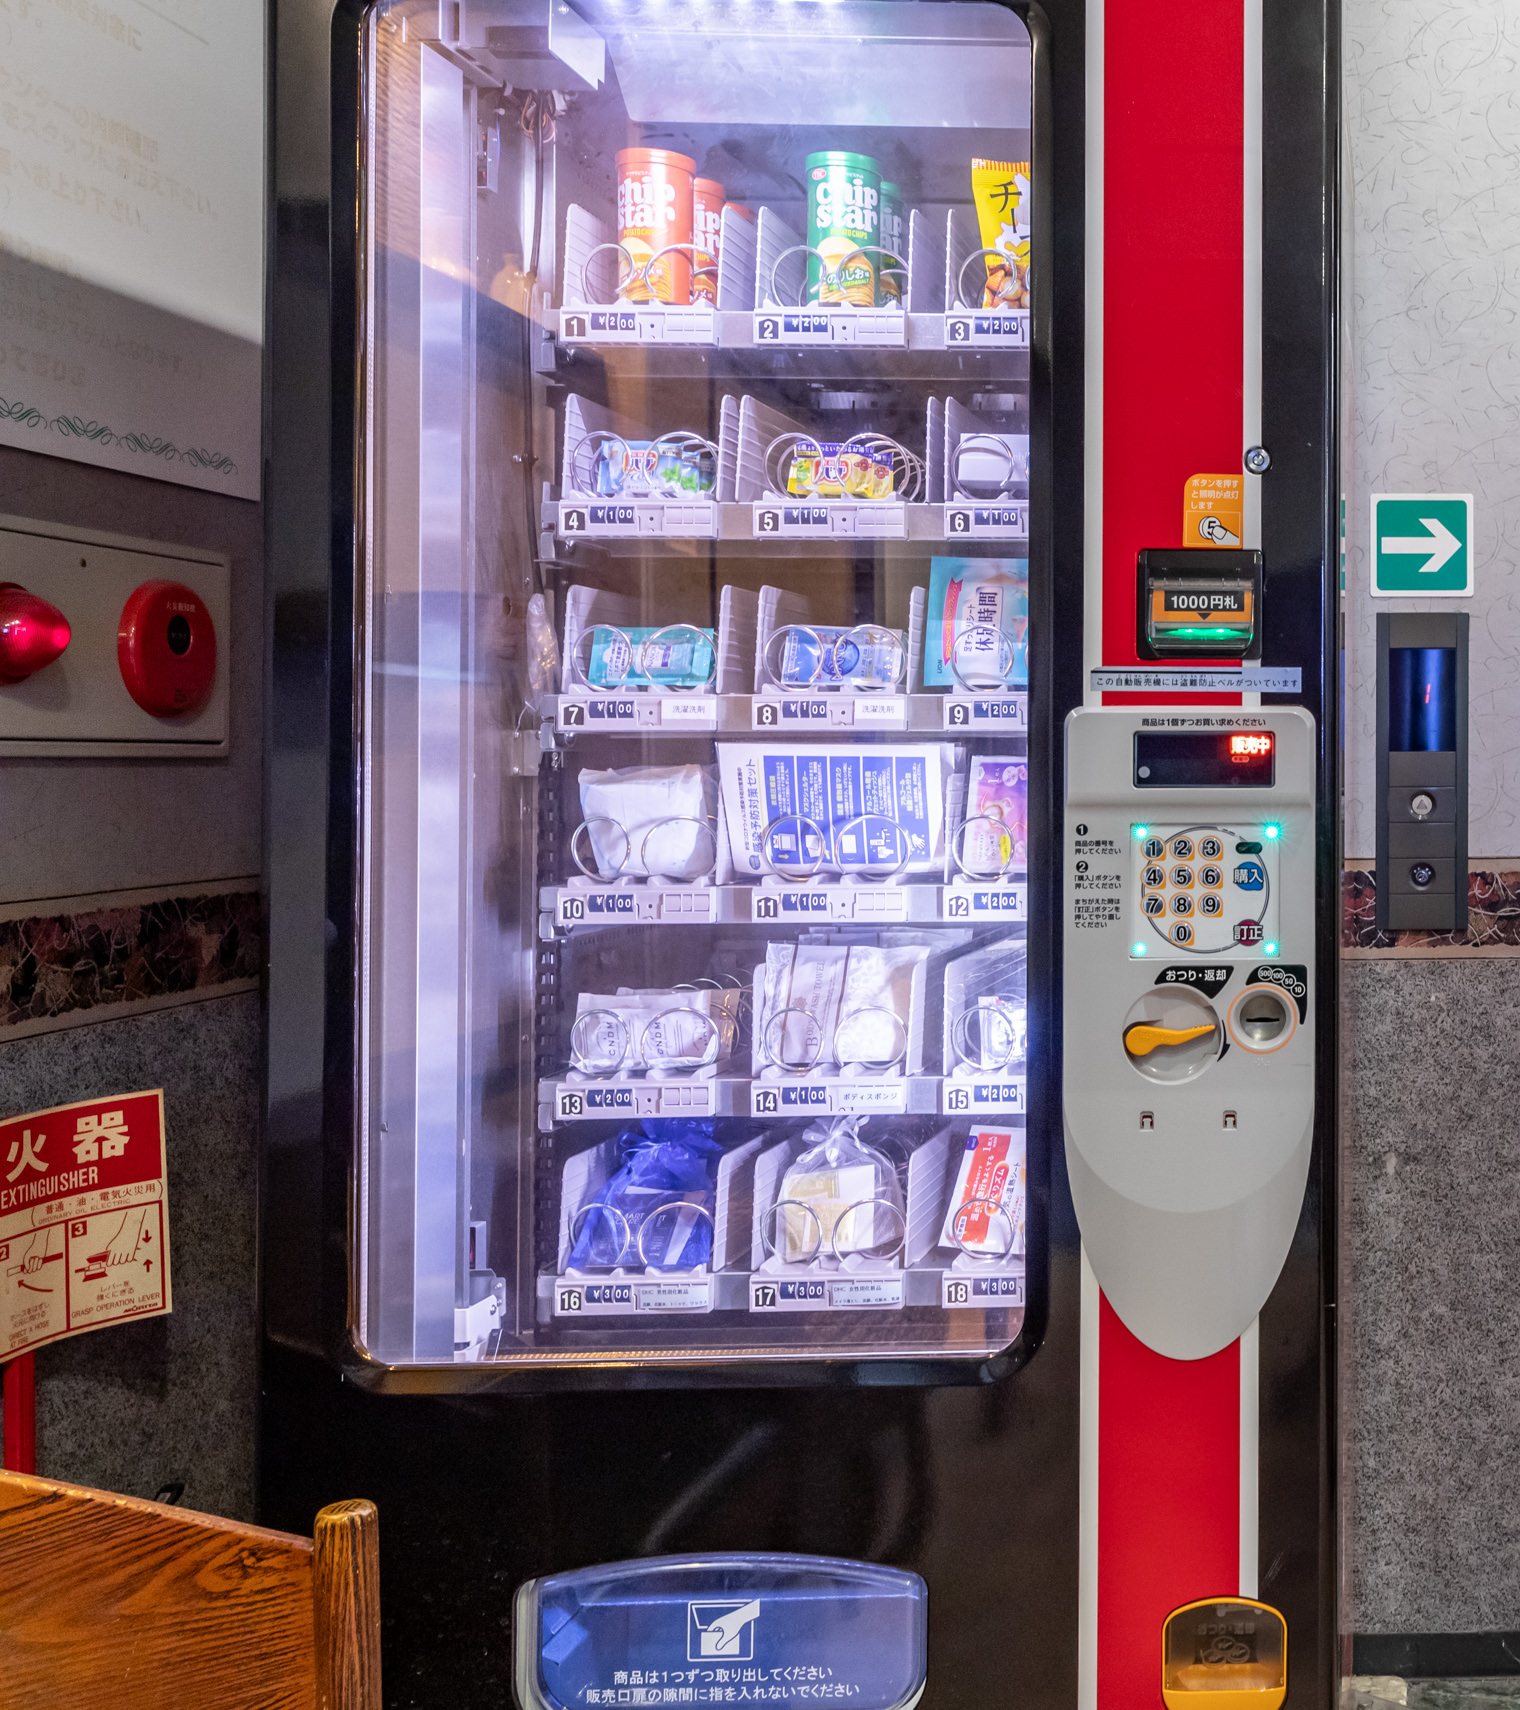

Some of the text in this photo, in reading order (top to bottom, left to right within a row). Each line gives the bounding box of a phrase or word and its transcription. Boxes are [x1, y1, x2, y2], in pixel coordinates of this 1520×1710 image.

[816, 204, 878, 233] star
[570, 315, 634, 335] 1 ¥200
[764, 316, 827, 338] 2 ¥200
[955, 321, 1017, 339] 3 ¥200
[1192, 479, 1238, 488] ボタンを押す
[1192, 491, 1238, 499] と照明が点灯
[569, 509, 632, 529] 4 ¥100
[764, 508, 826, 530] 5 ¥100
[955, 510, 1016, 531] 6 ¥100
[1171, 595, 1238, 609] 1000円札
[1096, 677, 1298, 688] この自動販売機には盗難防止ベルがついています
[569, 702, 705, 723] 7 ¥100 洗濯洗剤
[762, 702, 895, 723] 8 ¥100 洗濯洗剤
[954, 702, 1016, 723] 9 ¥200
[1141, 718, 1266, 727] 商品は1個ずつお買い求めください
[1231, 736, 1270, 754] 販売中
[1148, 840, 1215, 856] 1 2 3
[1074, 874, 1121, 882] 「購入」ボタンを
[1147, 868, 1216, 885] 4 5 6
[1234, 869, 1264, 884] 購入
[564, 896, 632, 917] 10 ¥100
[758, 894, 826, 917] 11 ¥100
[950, 895, 1015, 917] 12 ¥200
[1148, 897, 1216, 913] 7 8 9
[1177, 925, 1187, 941] 0
[1233, 925, 1264, 941] 訂正
[1166, 969, 1227, 981] おつり・返却
[1259, 970, 1272, 978] 500
[1273, 972, 1282, 980] 100
[563, 1092, 630, 1113] 13 ¥200
[757, 1092, 775, 1111] 14
[789, 1090, 825, 1100] ¥100
[948, 1088, 1016, 1109] 15 ¥200
[0, 1166, 99, 1210] EXTINGUISHER
[75, 1223, 84, 1235] 3
[561, 1290, 629, 1309] 16 ¥300
[756, 1285, 823, 1305] 17 ¥300
[948, 1282, 1014, 1303] 18 ¥300
[72, 1292, 160, 1318] GRASP OPERATION LEVER
[613, 1666, 833, 1685] 商品は1つずつ取り出してください
[586, 1683, 860, 1704] 販売口扉の隙間に指を入れないでください
